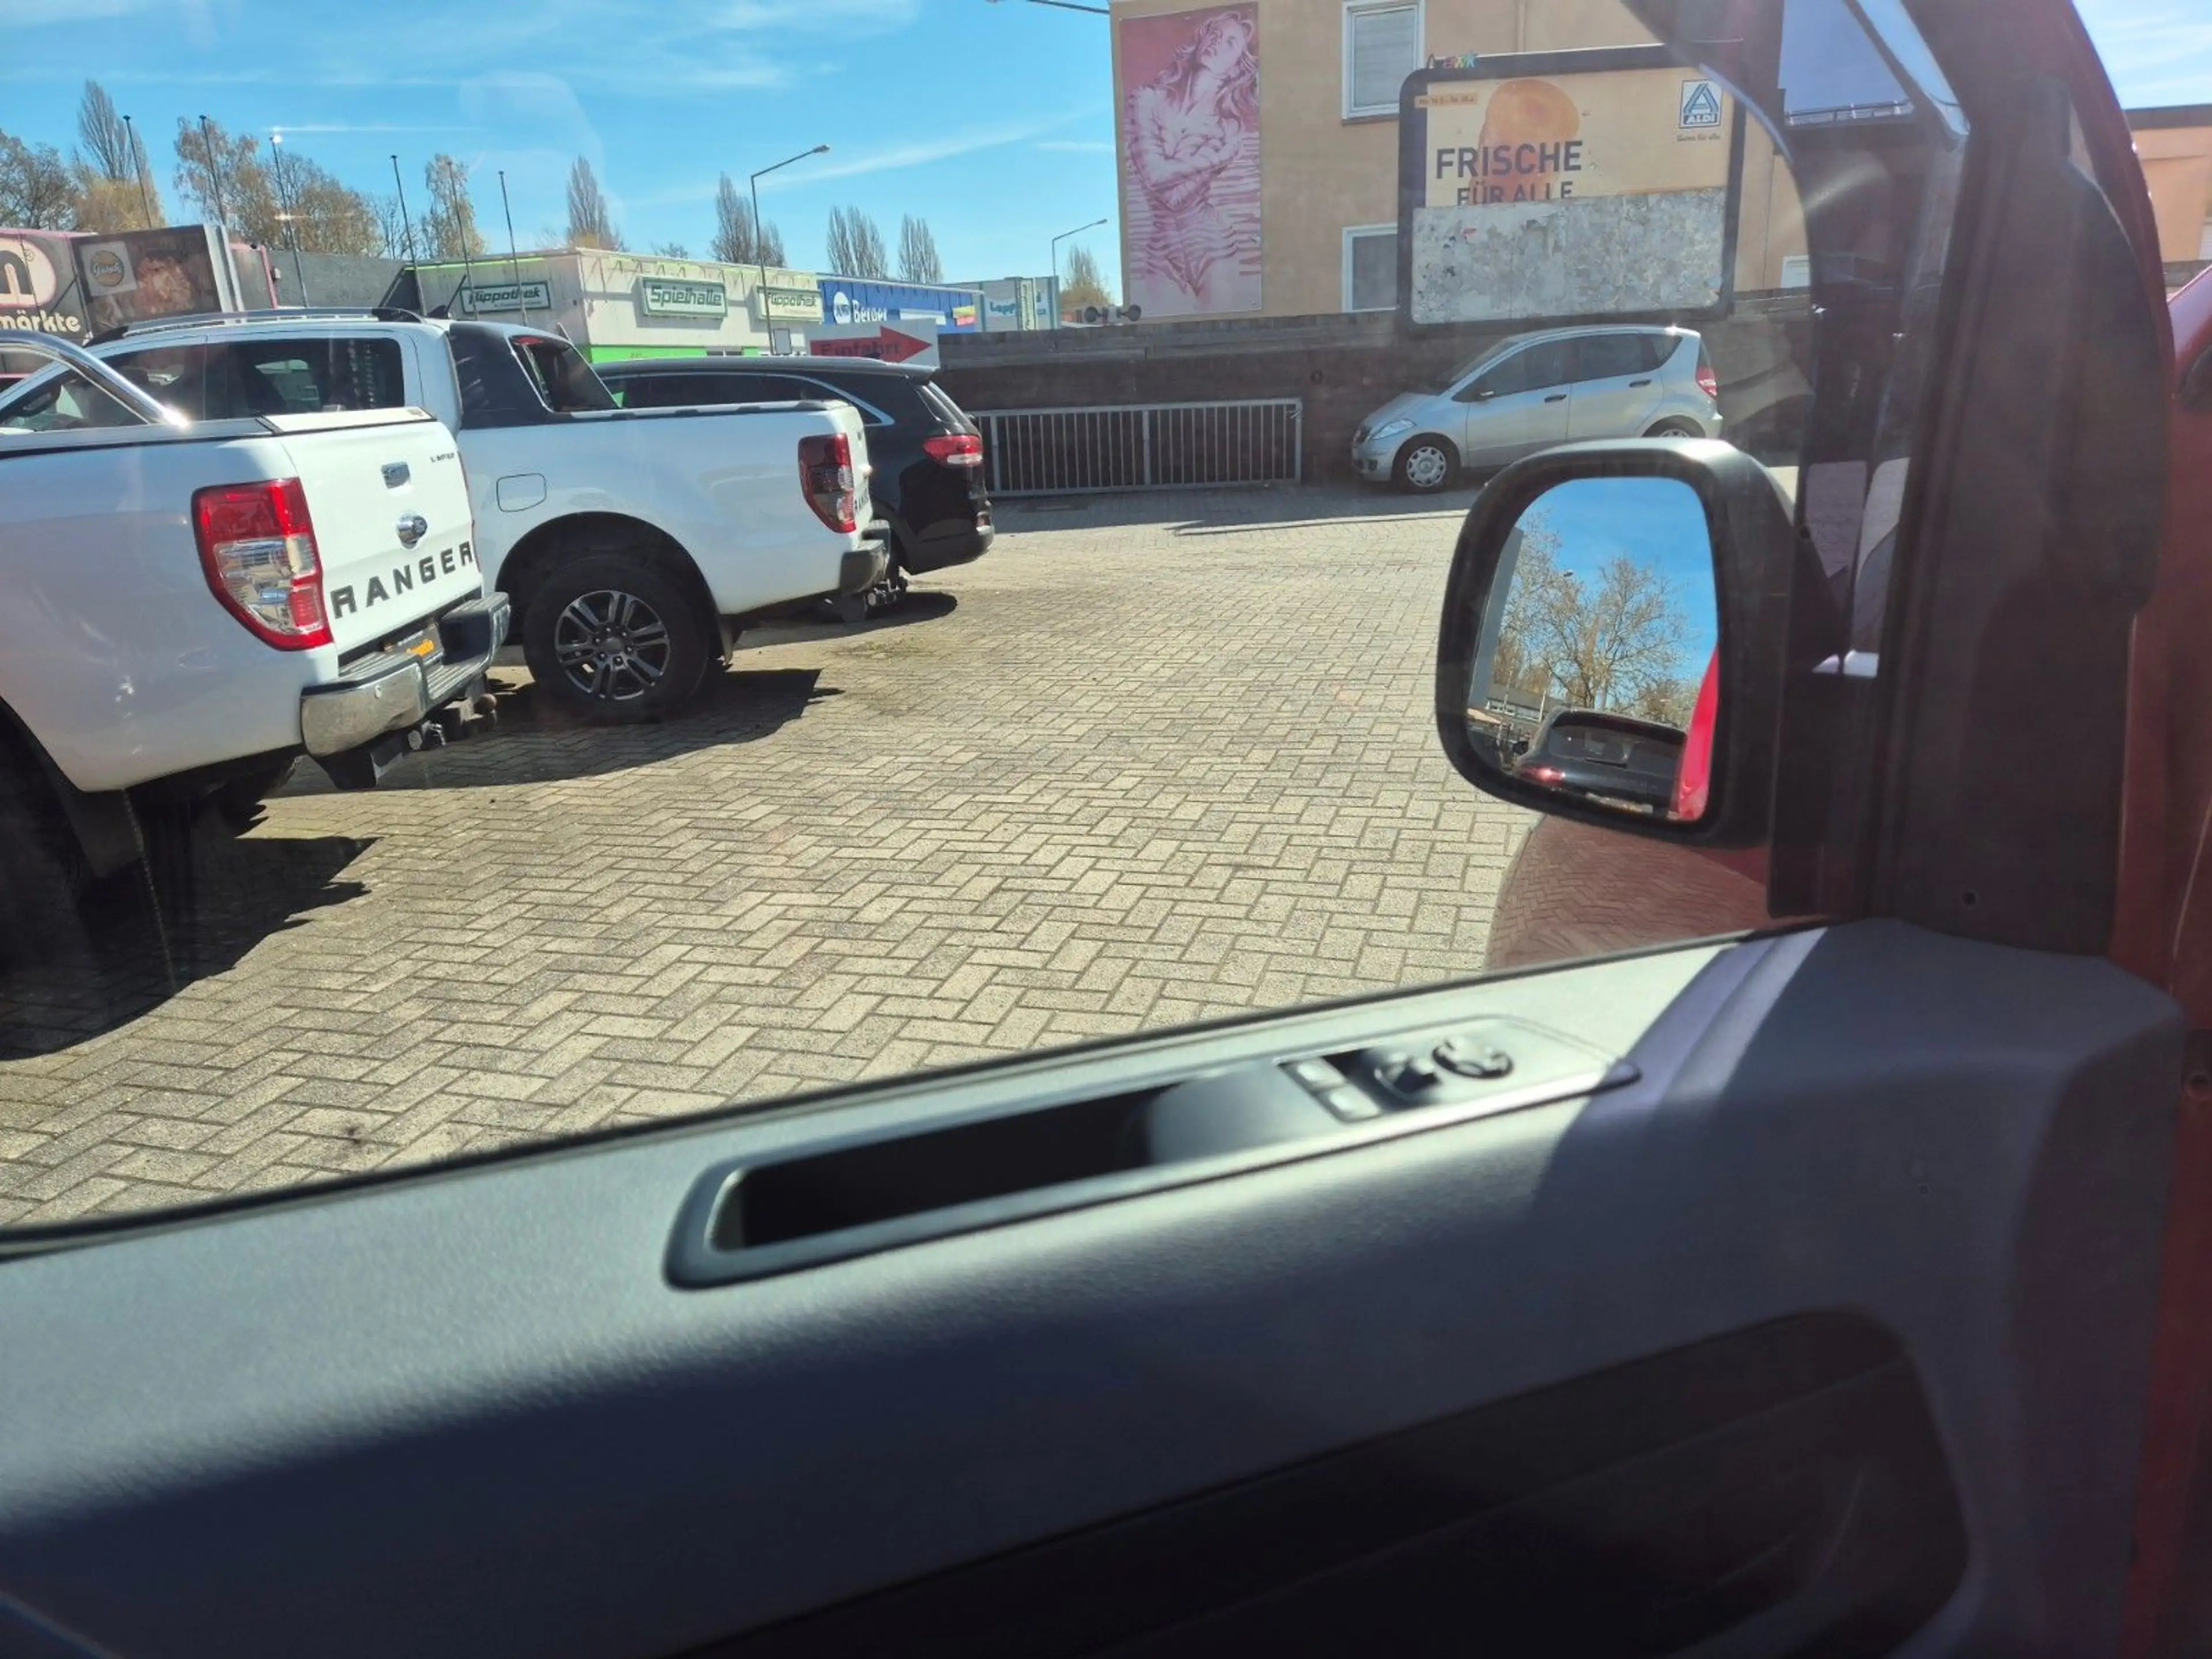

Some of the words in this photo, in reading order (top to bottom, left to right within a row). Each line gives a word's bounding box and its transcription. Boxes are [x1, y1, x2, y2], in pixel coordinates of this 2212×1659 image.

[1685, 113, 1717, 125] ALDI
[1436, 140, 1583, 179] FRISCHE
[1457, 180, 1506, 206] FÜR
[1513, 181, 1574, 202] ALLE
[650, 285, 722, 307] Spielhalle
[768, 290, 817, 308] lippothek
[0, 309, 81, 332] märkte
[330, 540, 473, 619] RANGER
